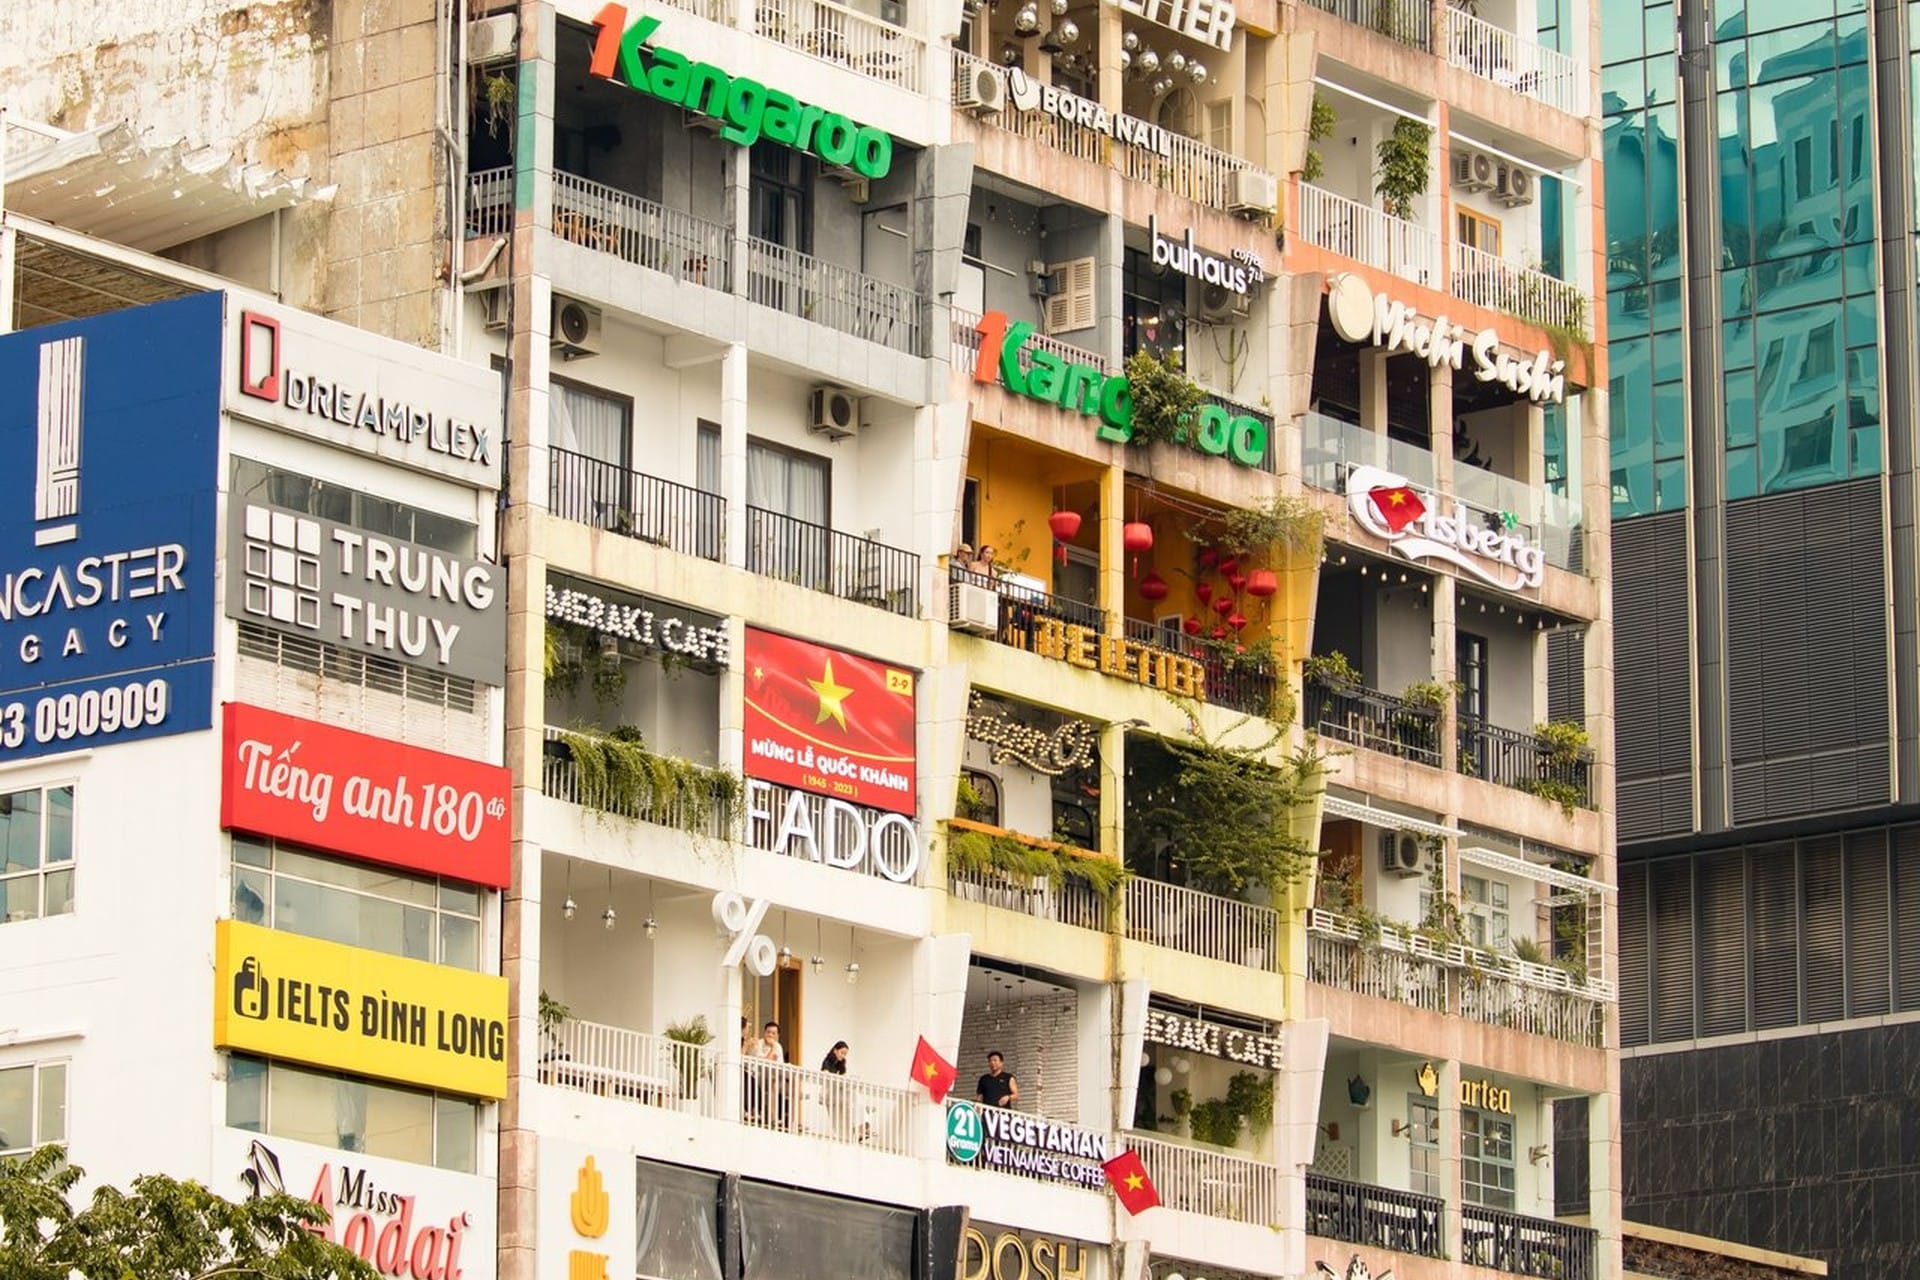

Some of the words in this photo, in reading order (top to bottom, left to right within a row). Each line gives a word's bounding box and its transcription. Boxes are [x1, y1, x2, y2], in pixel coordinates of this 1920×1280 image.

[1042, 87, 1111, 135] BORA
[1149, 213, 1247, 294] buhaus
[1373, 293, 1464, 370] Michi
[1472, 328, 1566, 404] Sushi
[285, 368, 493, 466] DREAMPLEX
[974, 310, 1268, 468] Kangoo
[1349, 465, 1545, 589] Clsberg
[333, 528, 494, 610] TRUNG
[333, 593, 460, 664] THUY
[546, 584, 654, 645] MERAKI
[35, 678, 168, 744] 090909
[892, 676, 908, 690] 2-9
[238, 740, 333, 823] Tiếng
[342, 775, 414, 829] anh
[419, 783, 485, 842] 180
[486, 797, 507, 822] độ
[751, 738, 795, 764] MỪNG
[817, 755, 858, 779] QUỐC
[860, 767, 909, 792] KHÁNH
[744, 777, 920, 883] FADO
[277, 976, 351, 1032] IELTS
[360, 989, 427, 1047] ĐÌNH
[437, 1009, 505, 1062] LONG
[1143, 1010, 1221, 1056] ERAKI
[949, 1135, 980, 1151] Grams
[953, 1107, 976, 1138] 21
[984, 1110, 1107, 1161] VEGETARIAN
[337, 1166, 400, 1215] Miss
[984, 1143, 1059, 1177] VIETNAMESE
[1061, 1160, 1105, 1187] COFFEE
[964, 1227, 1087, 1280] DOSH
